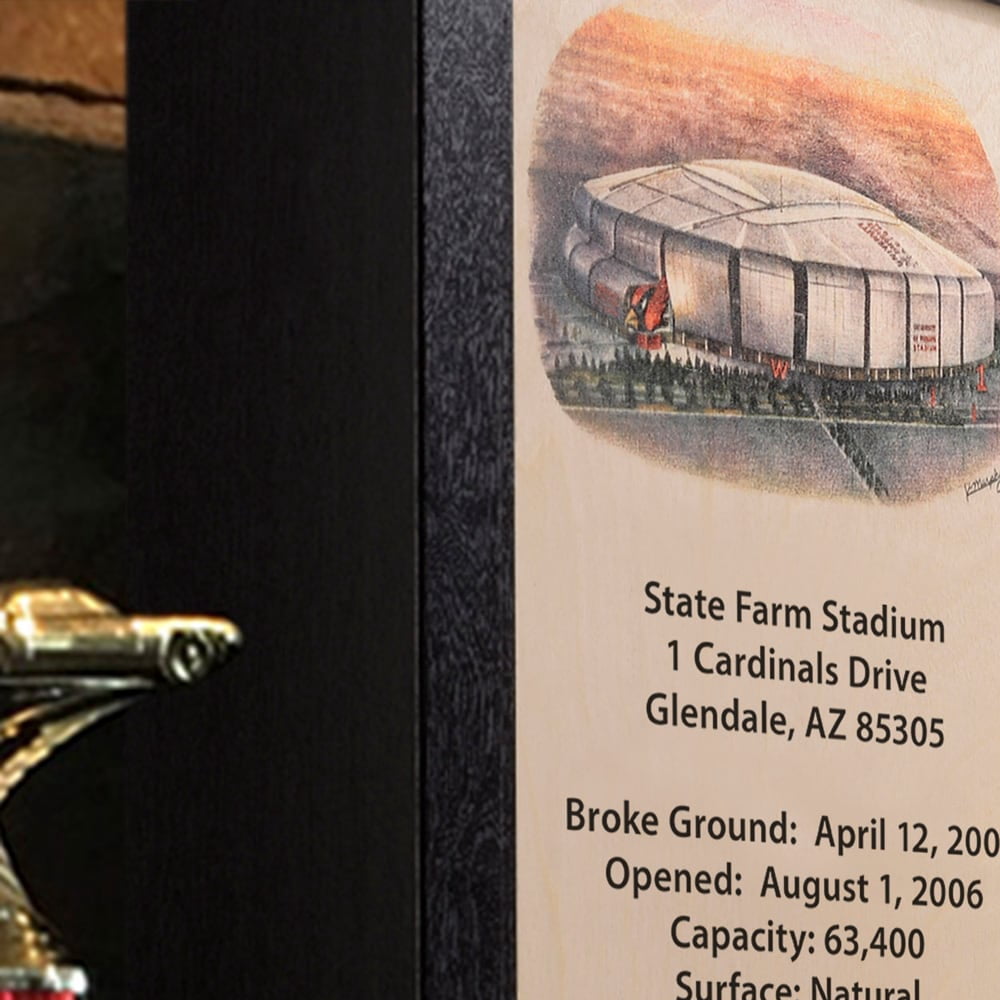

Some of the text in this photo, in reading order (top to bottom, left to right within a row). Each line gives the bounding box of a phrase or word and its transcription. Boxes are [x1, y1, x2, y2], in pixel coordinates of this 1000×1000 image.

[644, 580, 945, 643] State Farm Stadium
[667, 639, 927, 694] 1 Cardinals Drive
[645, 692, 945, 749] Glendale, AZ 85305
[566, 797, 659, 836] Broke
[669, 805, 797, 845] Ground:
[814, 815, 886, 857] April
[898, 821, 938, 859] 12,
[605, 856, 984, 910] Opened: August 1, 2006
[670, 915, 925, 963] Capacity: 63,400
